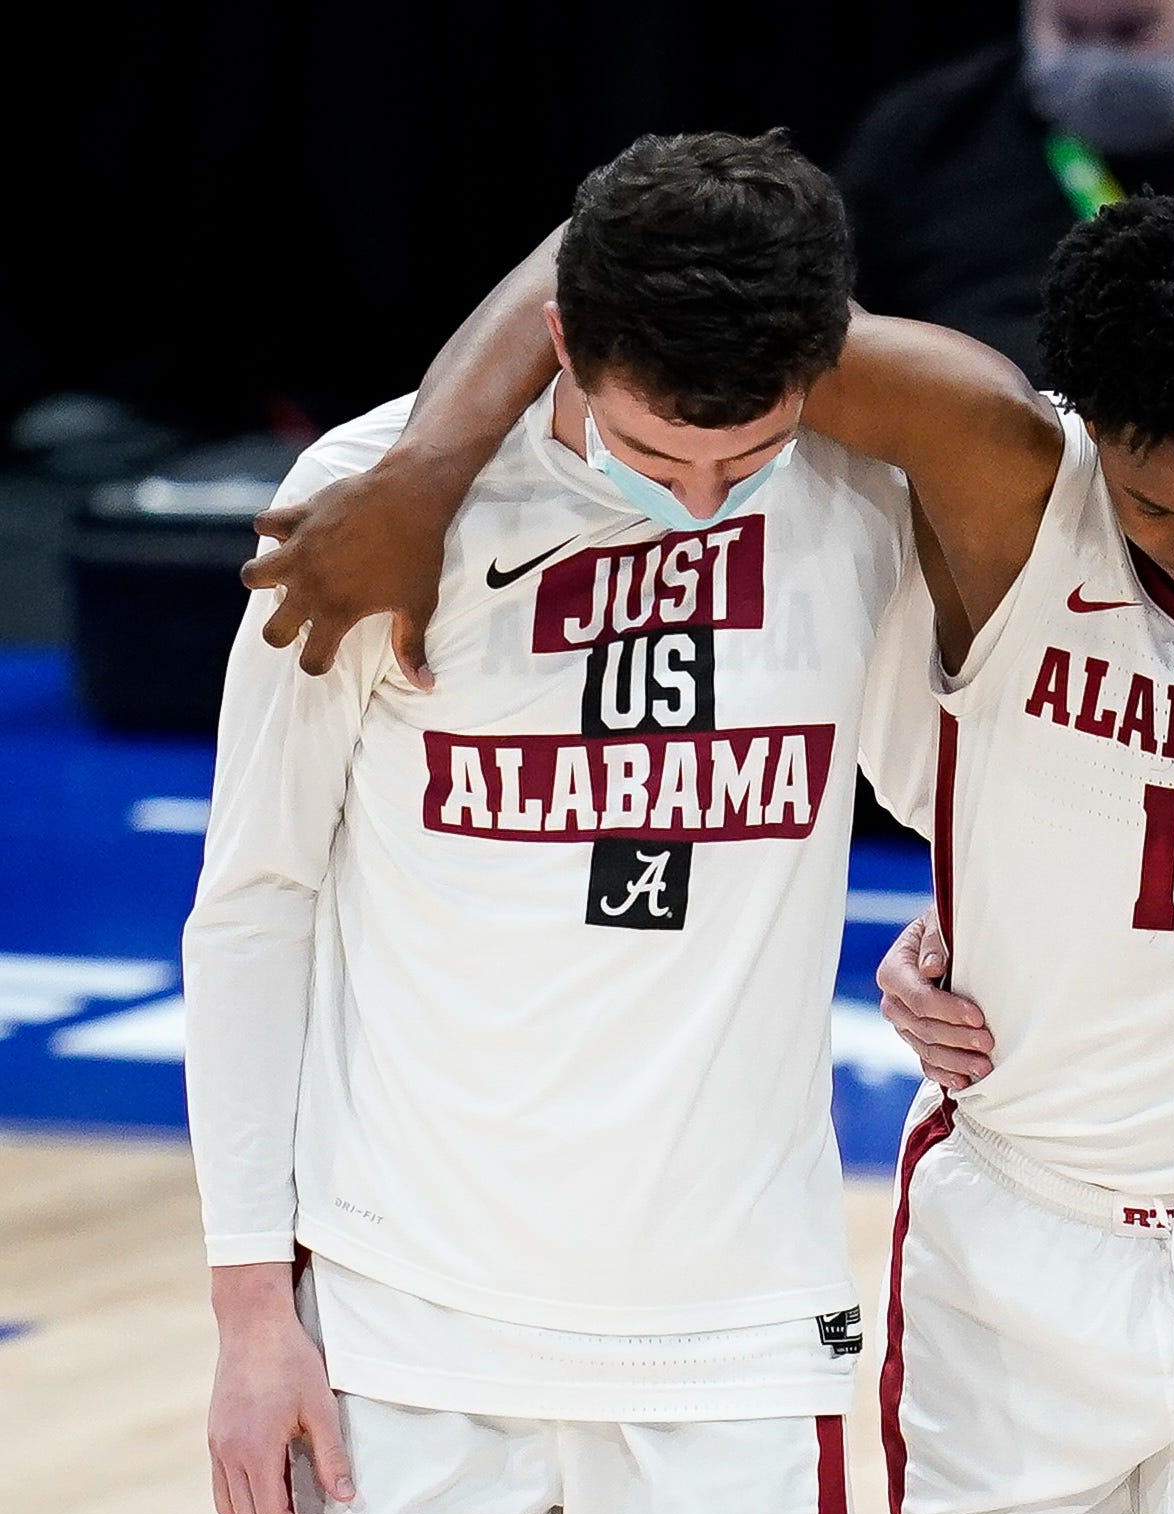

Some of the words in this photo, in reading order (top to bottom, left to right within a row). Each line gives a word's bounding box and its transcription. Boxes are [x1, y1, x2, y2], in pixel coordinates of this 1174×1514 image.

[563, 527, 743, 645] JUST
[600, 631, 697, 731] US
[440, 734, 812, 832] ALABAMA
[600, 849, 671, 918] A
[334, 1197, 384, 1225] DRI-FIT
